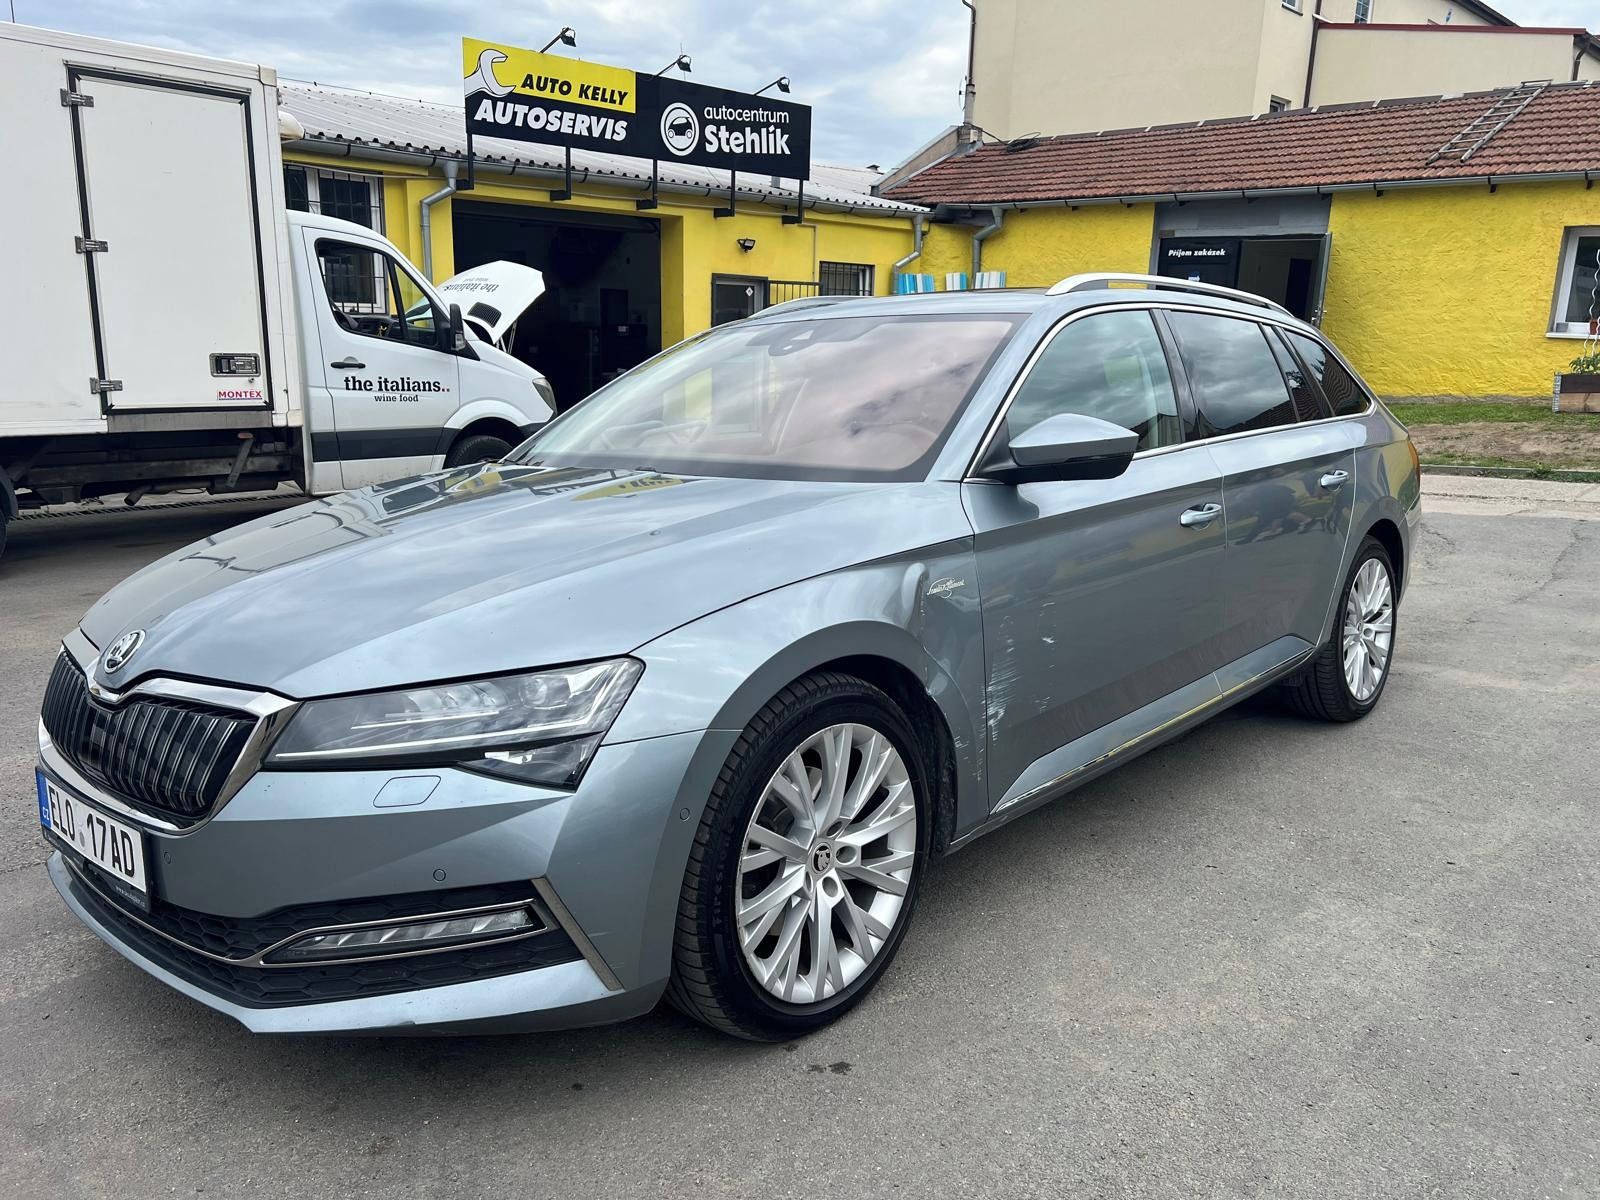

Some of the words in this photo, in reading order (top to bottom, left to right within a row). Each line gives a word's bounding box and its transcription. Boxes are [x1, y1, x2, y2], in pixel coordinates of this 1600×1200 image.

[521, 74, 572, 95] AUTO
[579, 83, 628, 106] KELLY
[474, 99, 627, 141] AUTOSERVIS
[704, 105, 789, 123] autocentrum
[704, 124, 791, 155] Stehlík
[1193, 248, 1226, 256] zakázek
[344, 376, 373, 391] the
[218, 390, 262, 398] MONTEX
[374, 394, 397, 402] wine
[399, 394, 419, 402] food
[42, 806, 50, 820] CZ
[86, 813, 135, 878] 17AD
